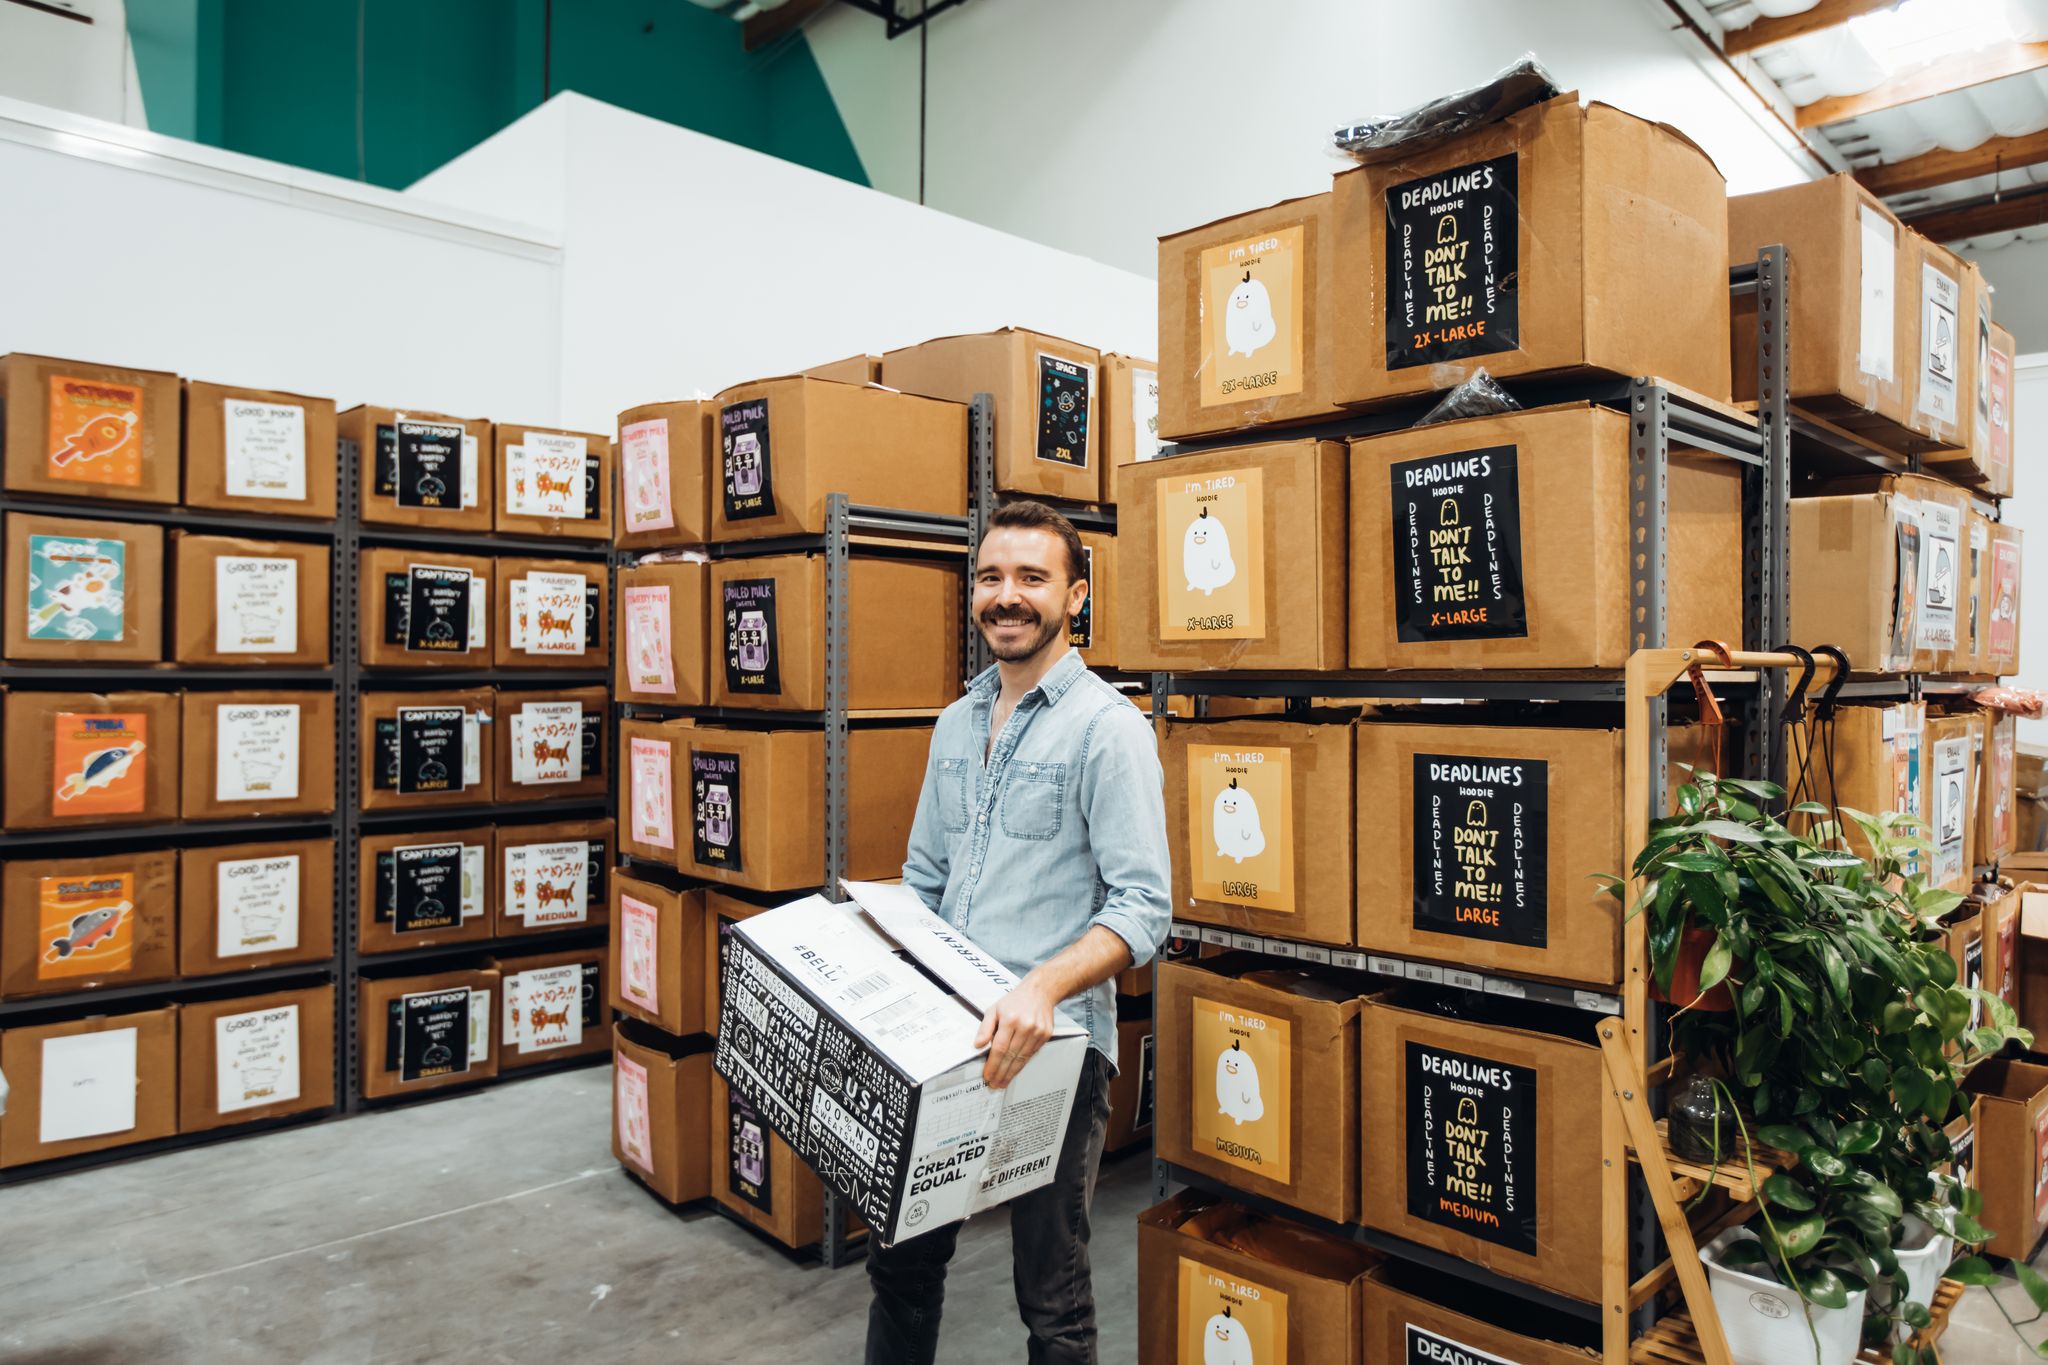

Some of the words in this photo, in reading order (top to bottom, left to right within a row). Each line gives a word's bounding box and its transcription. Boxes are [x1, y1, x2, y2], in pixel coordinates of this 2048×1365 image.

[1401, 167, 1494, 210] DEADLINES
[1429, 199, 1464, 217] HOODIE
[1248, 237, 1279, 256] TIRED
[1424, 240, 1470, 269] DON'T
[1239, 257, 1261, 268] HOODIE
[1483, 204, 1496, 315] DEADLINES
[1403, 223, 1414, 328] DEADLINES
[1425, 261, 1467, 287] TALK
[1433, 285, 1457, 304] TO
[1425, 294, 1473, 325] ME!!
[1413, 320, 1486, 349] 2X-LARGE
[1055, 361, 1078, 376] SPACE
[1222, 371, 1278, 395] 2X-LARGE
[742, 405, 765, 421] MILK
[433, 427, 460, 438] POOP
[537, 438, 576, 449] YAMERO
[1055, 446, 1073, 461] 2XL
[1405, 455, 1491, 488] DEADLINES
[1205, 476, 1236, 491] TIRED
[1432, 484, 1464, 498] HOODIE
[548, 503, 565, 513] 2XL
[1196, 494, 1218, 503] HOODIE
[1429, 526, 1472, 548] DON'T
[1483, 493, 1502, 601] DEADLINES
[1408, 501, 1423, 605] DEADLINES
[1430, 546, 1472, 566] TALK
[444, 571, 469, 582] POOP
[540, 577, 577, 586] YAMERO
[1438, 566, 1462, 584] TO
[725, 586, 750, 602] SPOILED
[750, 584, 771, 598] MILK
[1433, 579, 1479, 603] ME!!
[1187, 614, 1234, 632] X-LARGE
[1431, 607, 1488, 627] X-LARGE
[537, 642, 577, 651] X-LARGE
[1924, 628, 1951, 643] X-LARGE
[741, 674, 765, 685] X-LARGE
[434, 711, 461, 721] POOP
[535, 706, 573, 714] YAMERO
[693, 757, 717, 772] SPOILED
[718, 760, 736, 773] MILK
[1235, 752, 1265, 764] TIRED
[538, 770, 568, 780] LARGE
[1225, 766, 1248, 775] HOODIE
[1430, 763, 1523, 787] DEADLINES
[1459, 786, 1494, 799] HOODIE
[1432, 794, 1443, 896] DEADLINES
[1453, 826, 1499, 848] DON'T
[431, 847, 459, 858] POOP
[539, 846, 578, 856] YAMERO
[708, 847, 726, 860] LARGE
[1454, 845, 1496, 867] TALK
[1513, 802, 1525, 908] DEADLINES
[1462, 865, 1486, 882] TO
[1222, 880, 1258, 900] LARGE
[1454, 880, 1502, 903] ME!!
[536, 911, 578, 921] MEDIUM
[1455, 905, 1500, 927] LARGE
[931, 929, 1010, 986] DIFFERENT
[531, 969, 572, 981] YAMERO
[440, 991, 466, 1004] POOP
[715, 1022, 727, 1068] MILLIONS
[730, 936, 738, 965] MADE
[722, 1039, 731, 1062] THE
[729, 969, 739, 1007] EVERY
[734, 942, 743, 970] YEAR
[739, 969, 767, 997] FAST
[763, 993, 815, 1041] FASHION
[754, 969, 814, 1027] MANUFACTURING
[1229, 1027, 1251, 1038] HOODIE
[1238, 1015, 1267, 1031] TIRED
[536, 1034, 568, 1047] SMALL
[769, 1016, 781, 1033] #1
[782, 1026, 812, 1060] SHIRT
[812, 1017, 827, 1063] MOVEMENT.
[827, 1021, 857, 1051] FLOWY
[766, 1026, 786, 1053] FOR
[788, 1046, 808, 1073] DTG
[754, 1041, 804, 1099] NEVER
[809, 1063, 818, 1079] THE
[1421, 1053, 1512, 1091] DEADLINES
[754, 1056, 801, 1112] TUBULAR
[806, 1080, 814, 1100] JOIN
[1450, 1081, 1484, 1099] HOODIE
[728, 1055, 799, 1138] SUPERIOR
[845, 1076, 884, 1125] USA
[727, 1068, 753, 1100] PRINT
[757, 1098, 799, 1148] SURFACE
[843, 1095, 882, 1136] STRONG
[817, 1092, 852, 1132] 100%
[855, 1127, 875, 1151] NO
[814, 1104, 875, 1163] SWEATSHOPS
[1423, 1085, 1435, 1186] DEADLINES
[1445, 1120, 1489, 1148] DON'T
[912, 1145, 986, 1180] CREATED
[1445, 1139, 1487, 1167] TALK
[1503, 1106, 1515, 1212] DEADLINES
[807, 1135, 871, 1214] PRISM
[868, 1193, 880, 1226] LOS
[875, 1108, 896, 1187] ANGELES
[876, 1116, 906, 1233] CALIFORNIA
[998, 1154, 1052, 1184] DIFFERENT
[1453, 1160, 1476, 1180] TO
[909, 1167, 967, 1197] EQUAL.
[1446, 1174, 1492, 1203] ME!!
[913, 1205, 923, 1214] NO
[1229, 1281, 1260, 1301] TIRED
